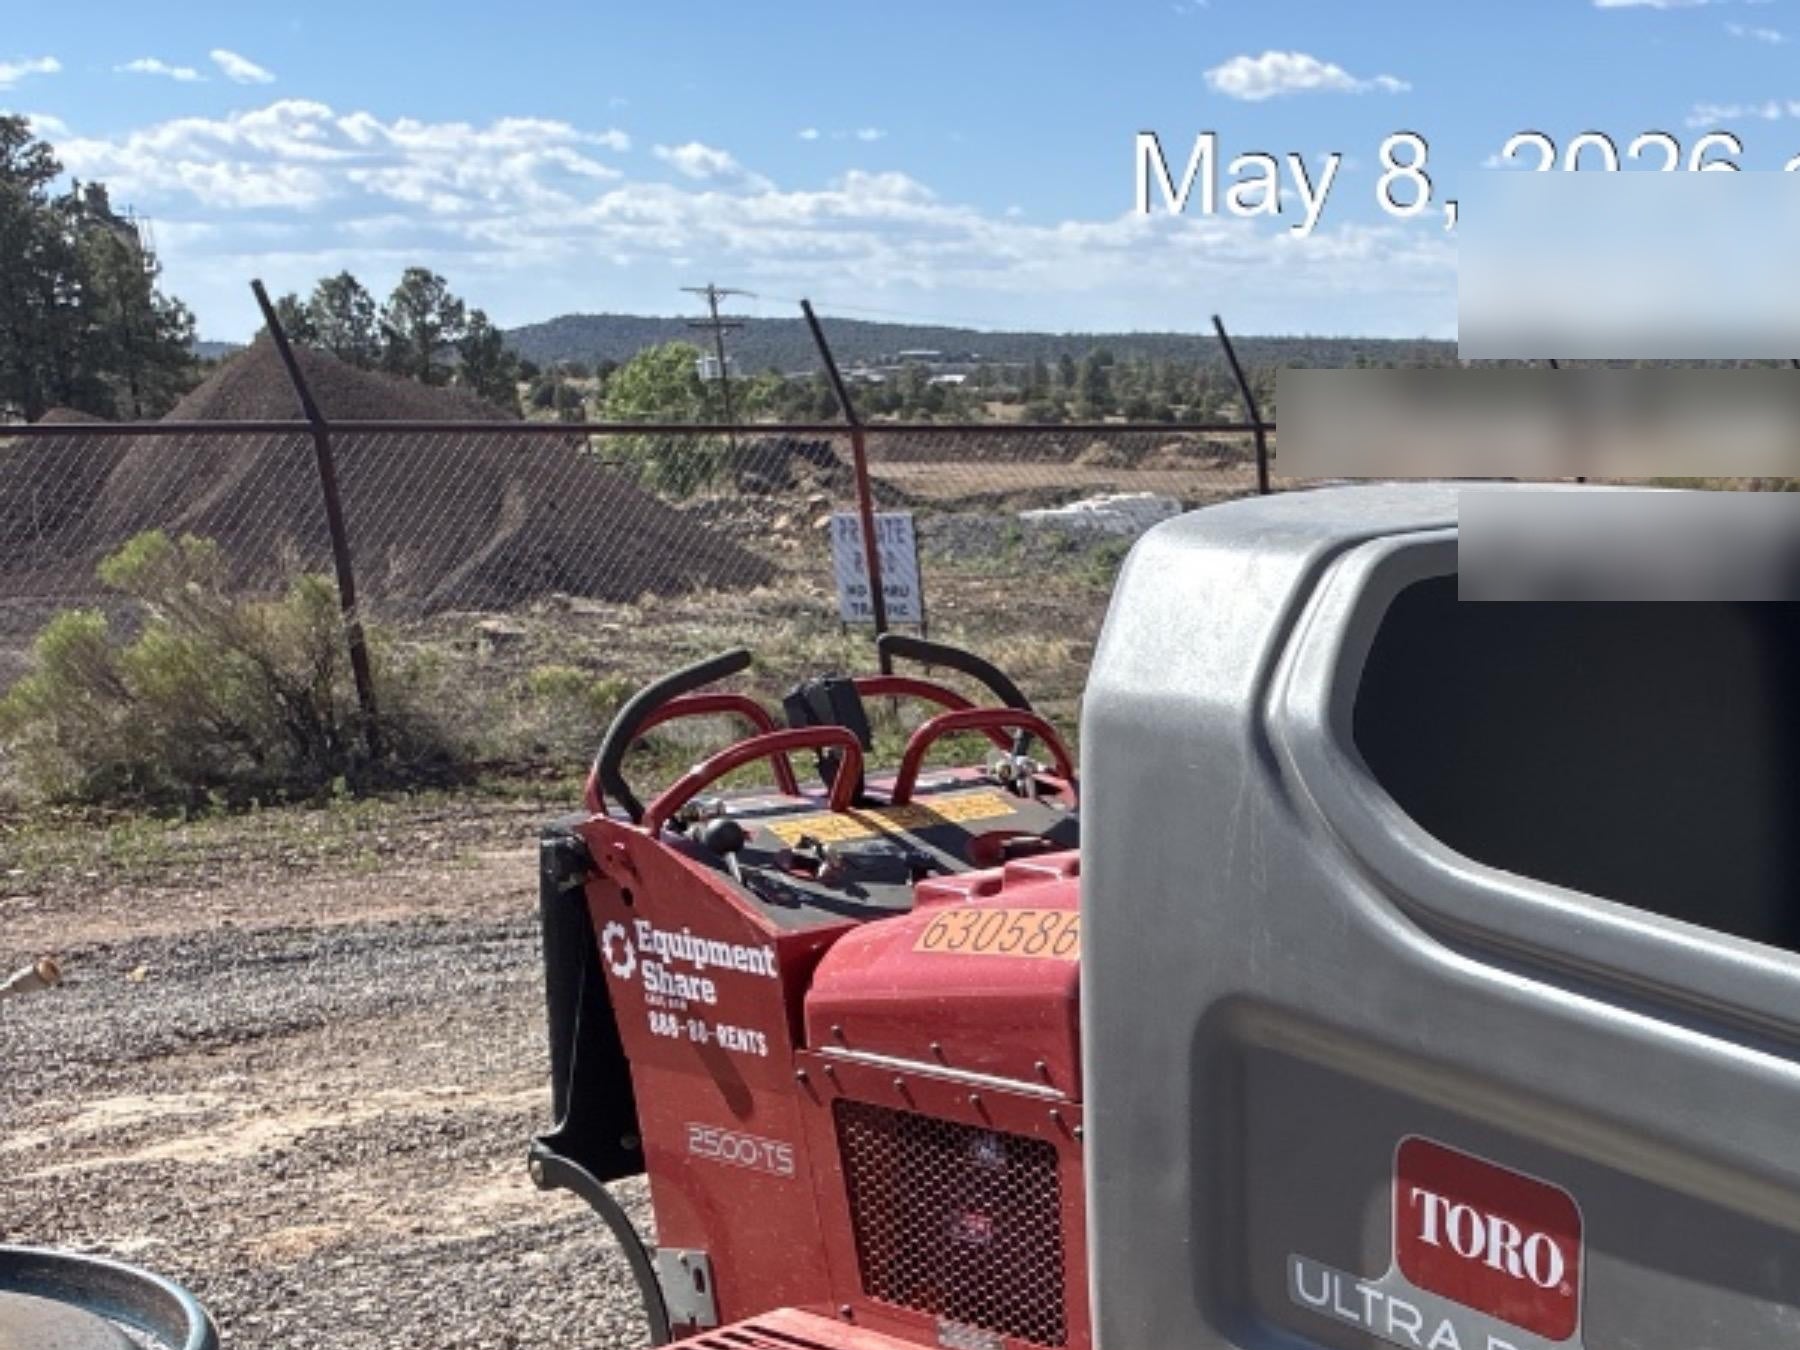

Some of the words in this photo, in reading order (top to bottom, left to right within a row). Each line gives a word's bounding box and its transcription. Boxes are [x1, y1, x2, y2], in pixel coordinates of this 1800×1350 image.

[633, 918, 778, 979] Equipment
[923, 910, 1081, 956] 630586
[641, 960, 718, 1005] Share
[1409, 1186, 1566, 1290] TORO
